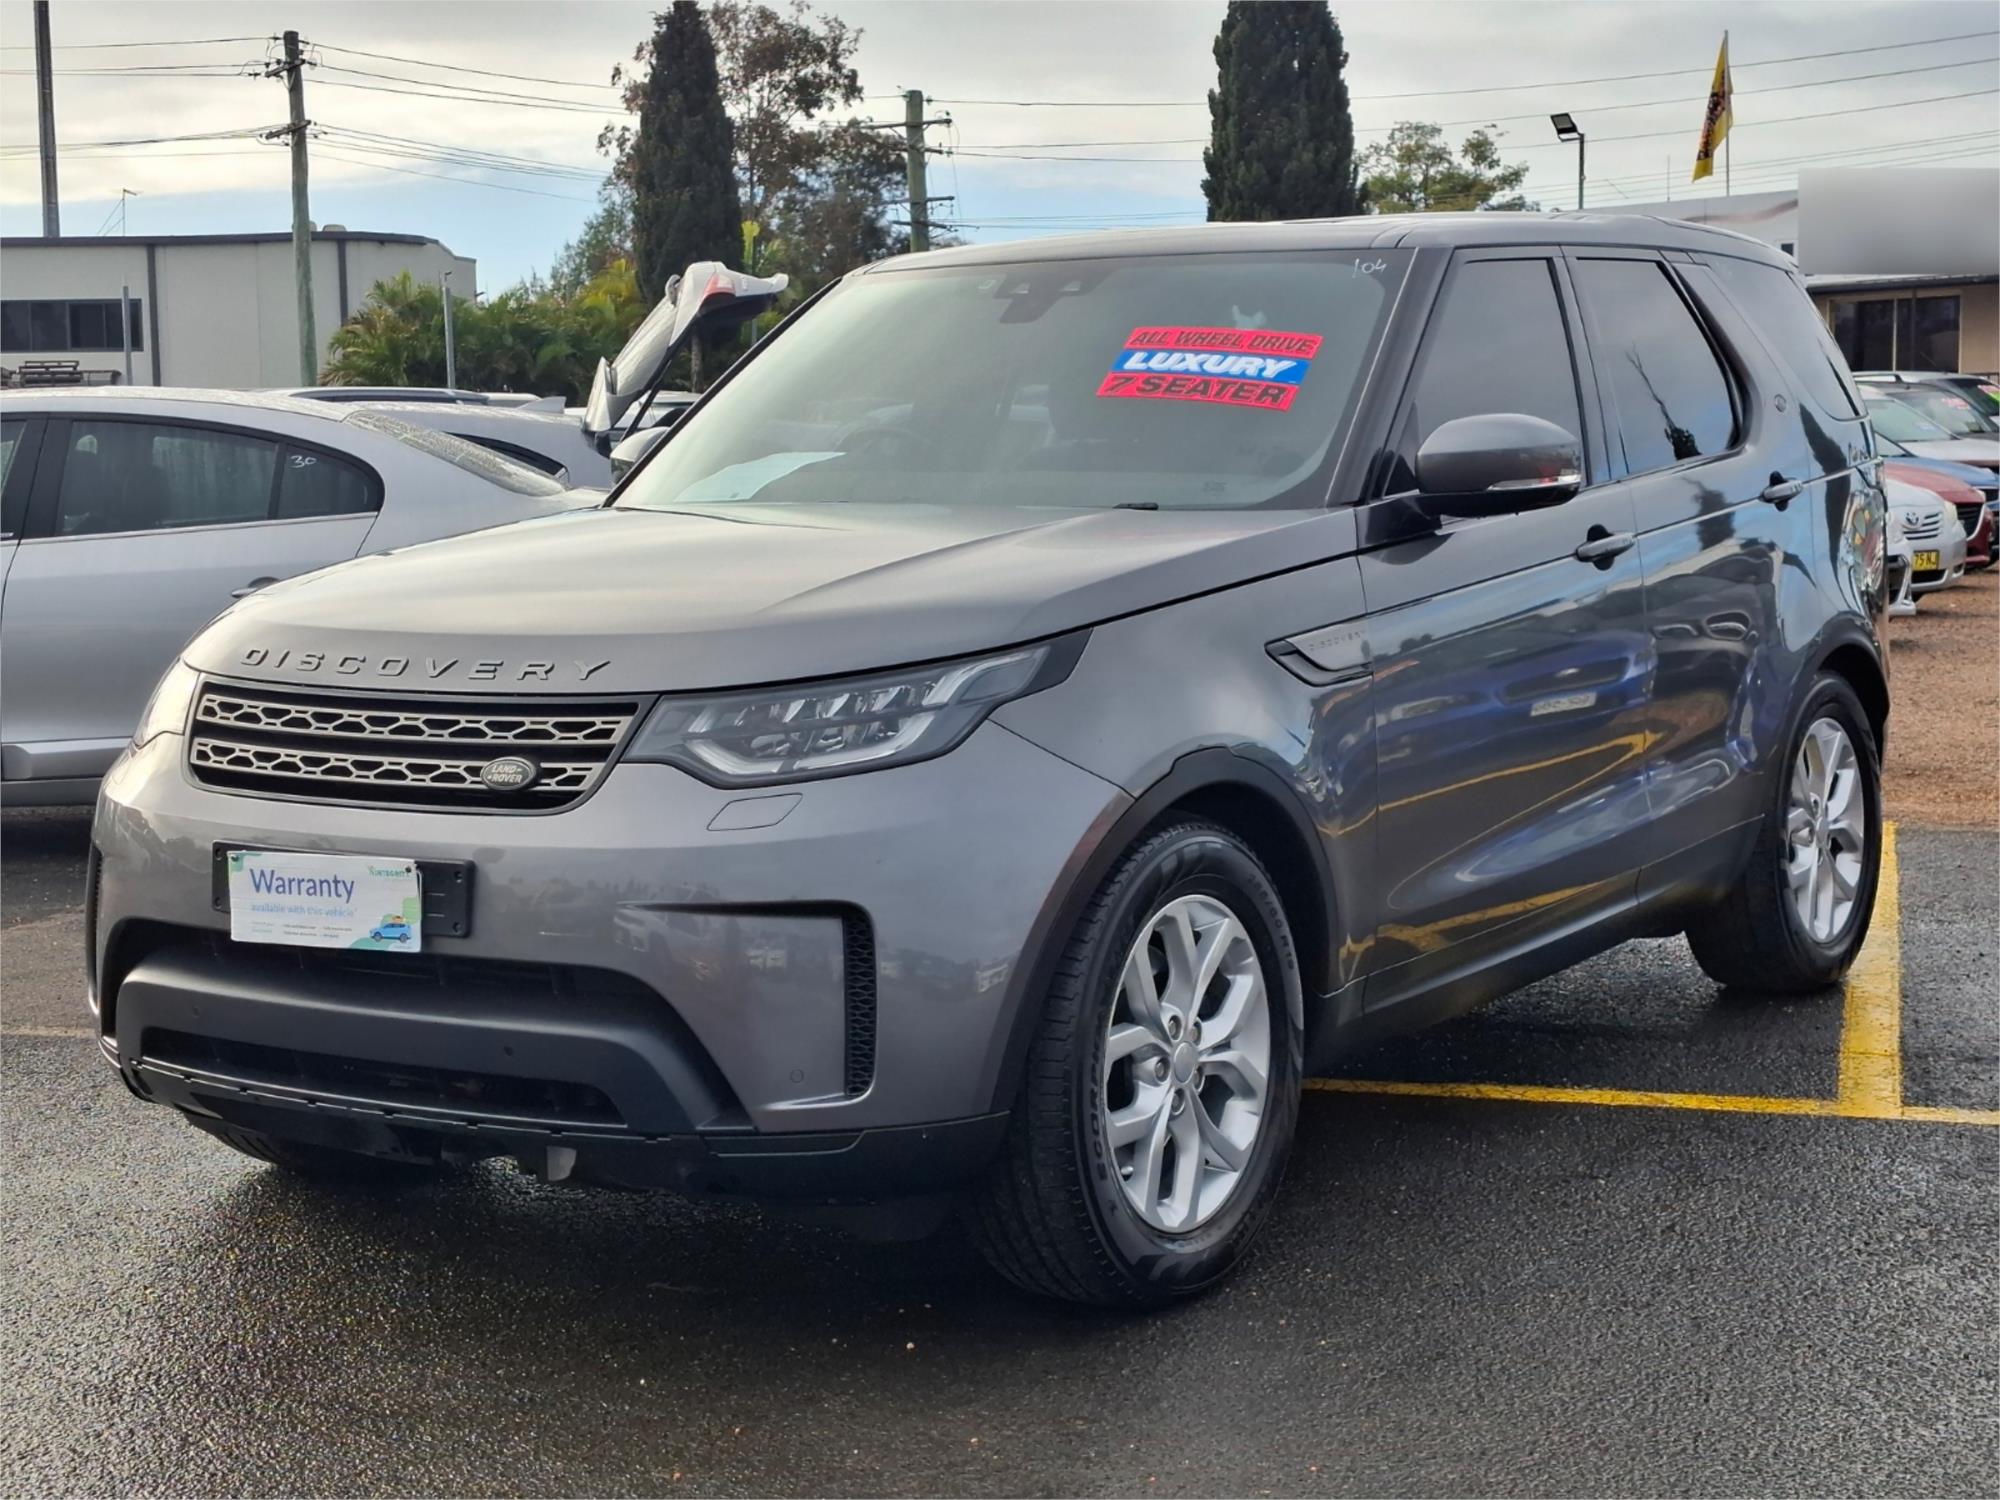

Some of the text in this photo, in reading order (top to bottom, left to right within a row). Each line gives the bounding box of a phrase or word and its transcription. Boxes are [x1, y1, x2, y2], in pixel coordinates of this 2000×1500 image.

[1352, 258, 1387, 278] 104
[1131, 331, 1317, 351] ALL WHEEL DRIVE
[1123, 351, 1297, 378] LUXURY
[1106, 376, 1288, 405] 7 SEATER
[290, 455, 317, 468] 30
[239, 648, 612, 682] DISCOVERY
[249, 868, 355, 904] Warranty
[251, 903, 286, 913] available
[288, 904, 305, 915] with
[307, 905, 323, 916] this
